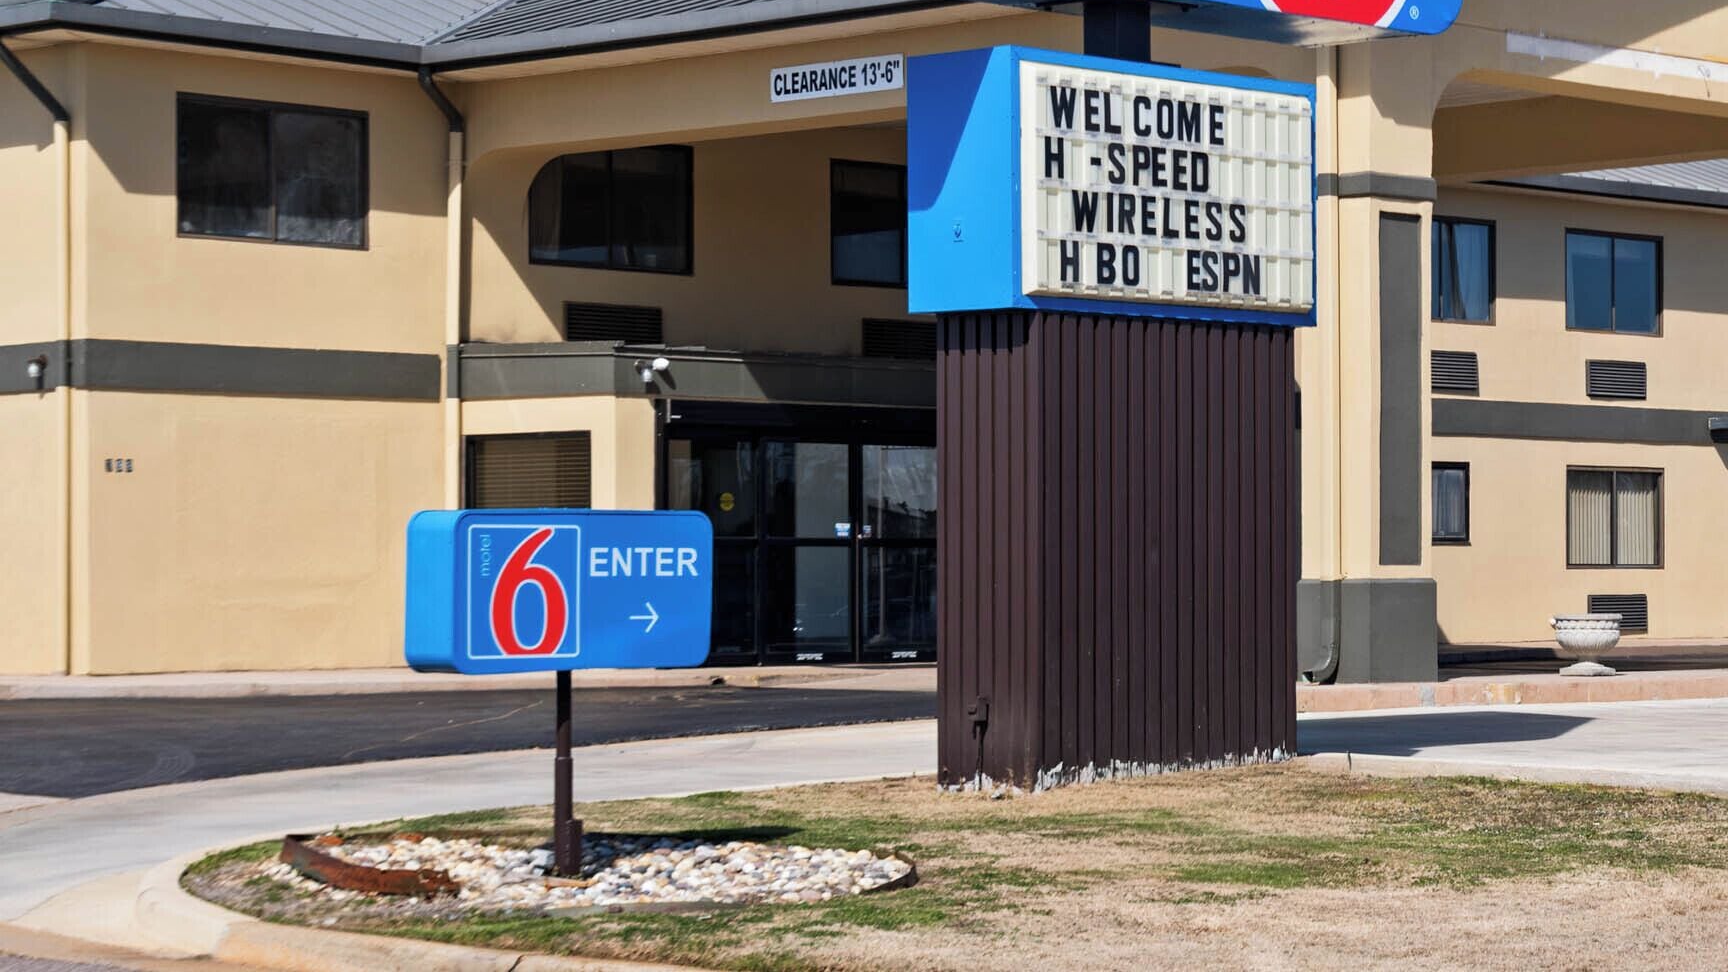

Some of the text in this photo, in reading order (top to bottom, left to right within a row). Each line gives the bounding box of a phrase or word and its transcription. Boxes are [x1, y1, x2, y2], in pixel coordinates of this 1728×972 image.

[774, 60, 900, 96] CLEARANCE 13'-6"
[1072, 189, 1246, 243] WIRELESS
[1187, 250, 1261, 295] ESPN
[589, 547, 699, 577] ENTER
[480, 527, 569, 656] motel 6
